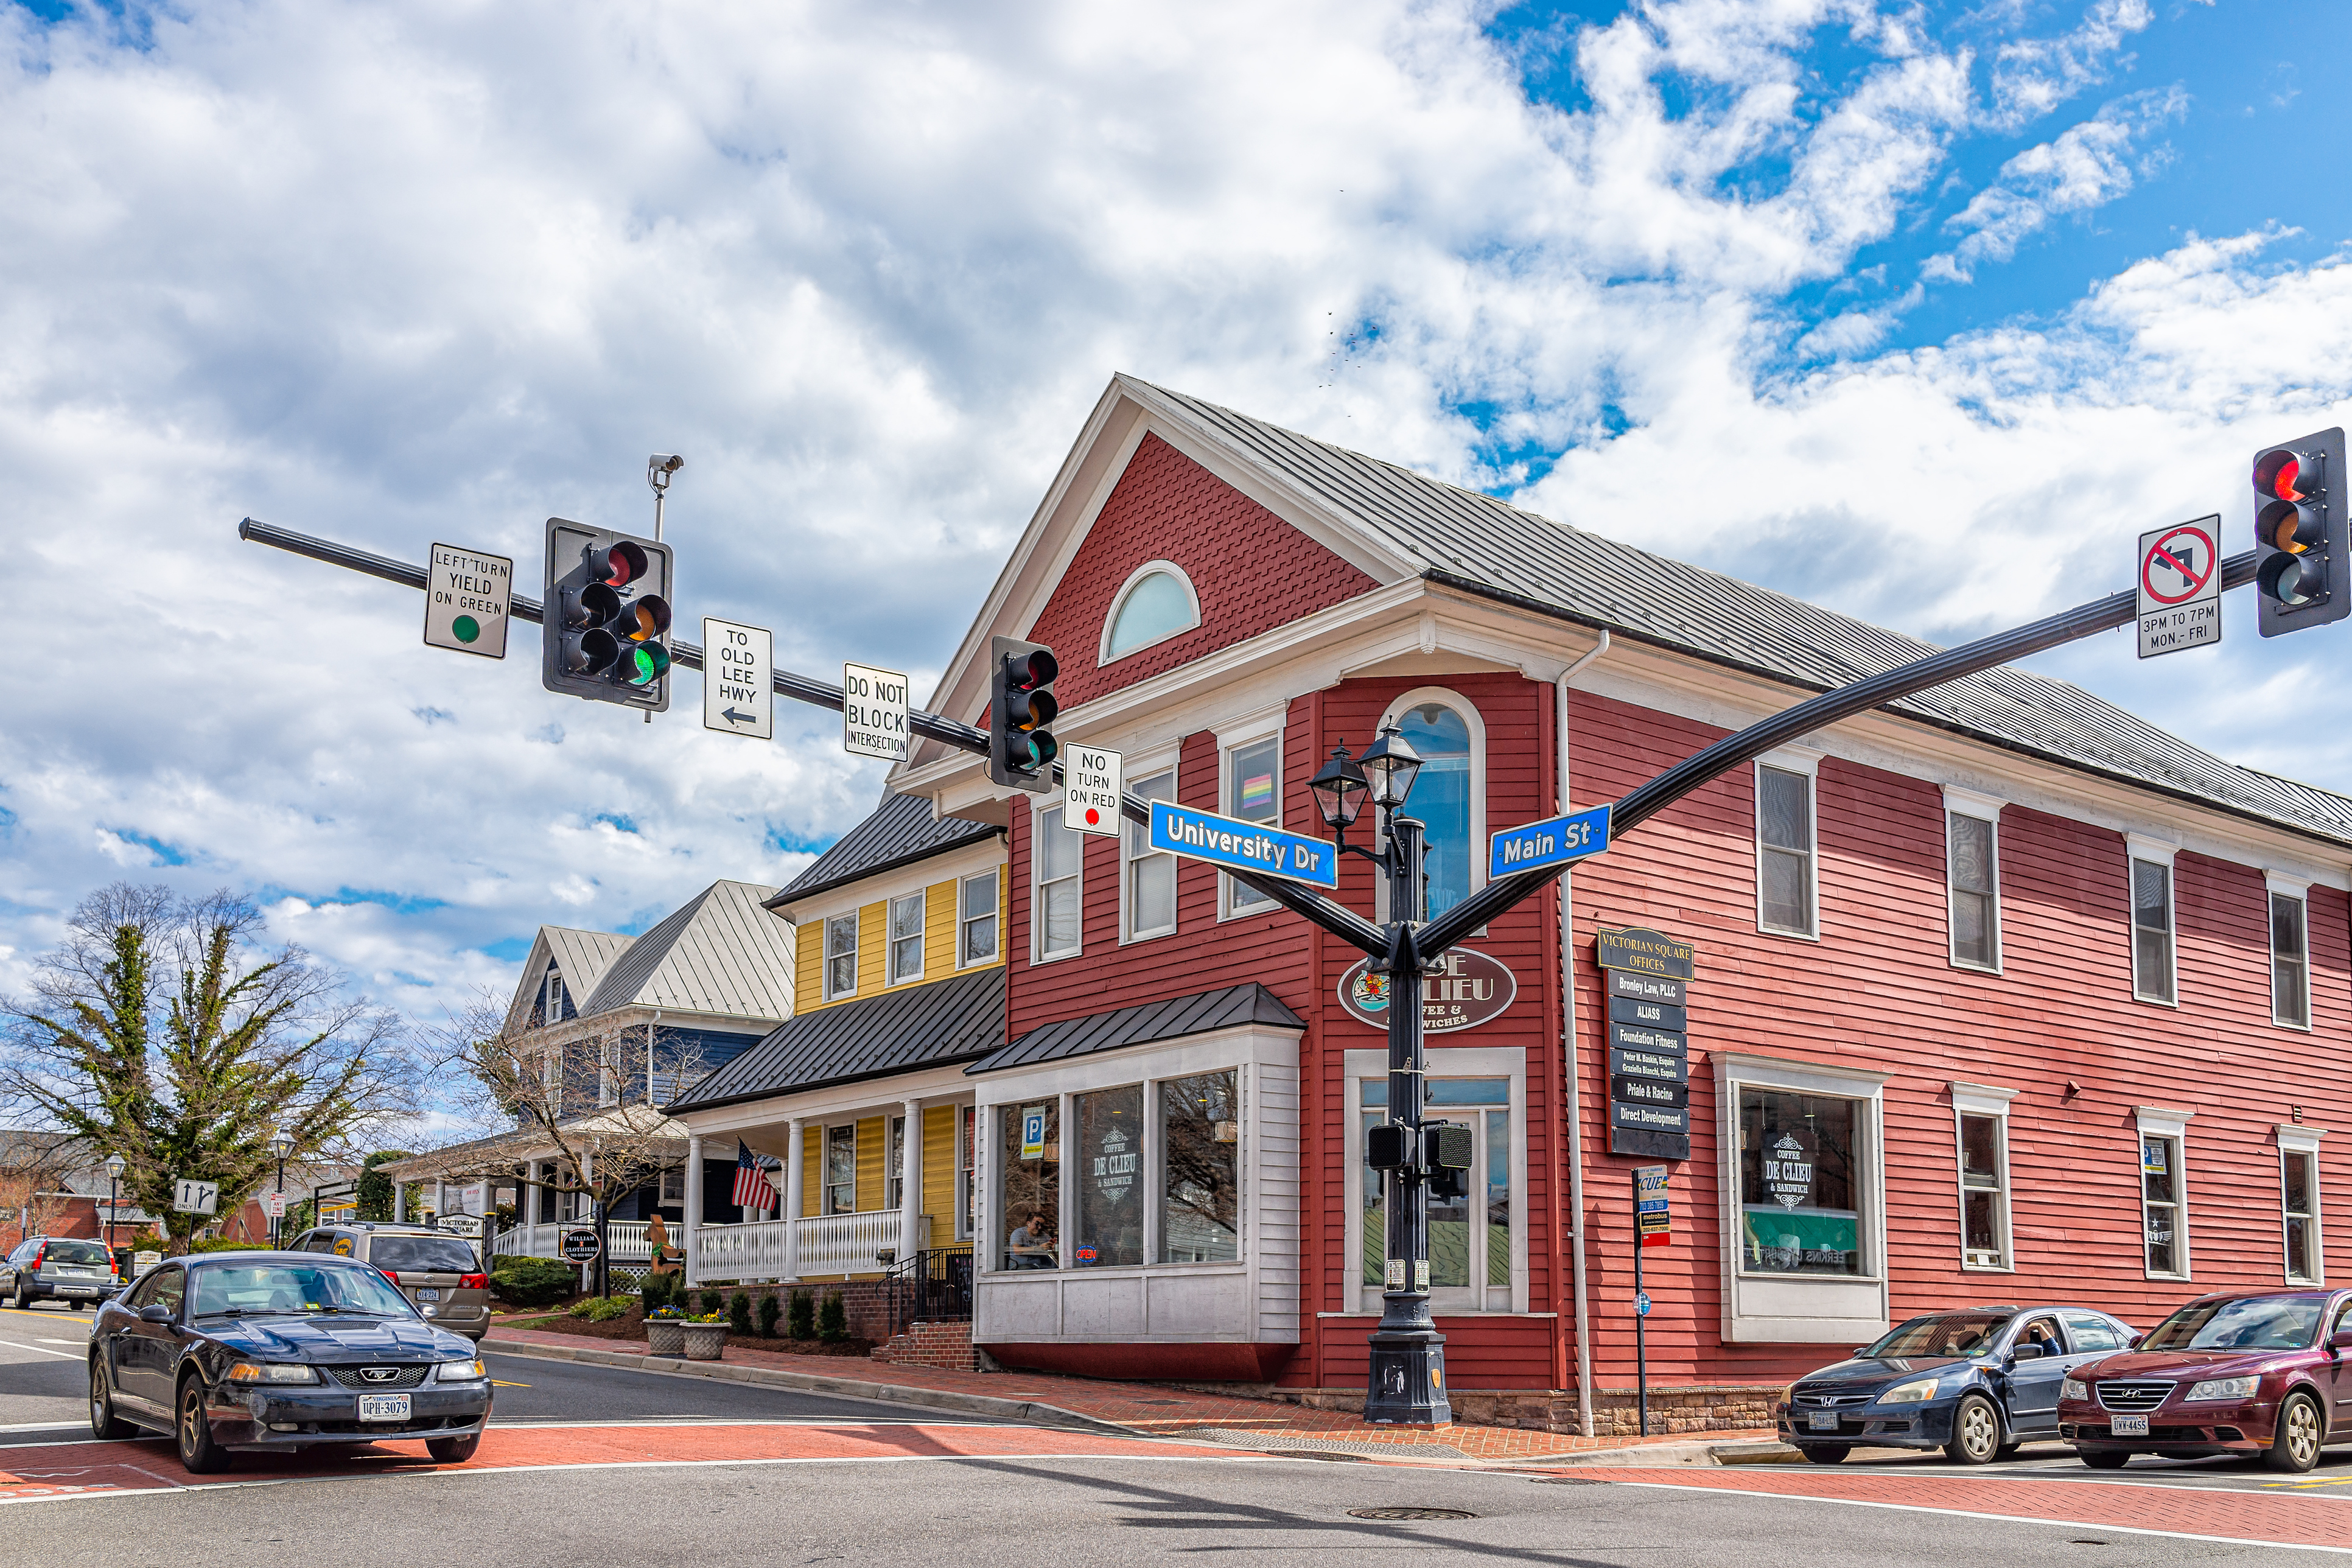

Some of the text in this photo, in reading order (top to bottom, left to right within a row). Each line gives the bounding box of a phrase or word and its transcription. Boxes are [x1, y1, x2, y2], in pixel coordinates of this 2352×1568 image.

[435, 551, 508, 578] LEFT TURN
[449, 573, 492, 595] YIELD
[435, 591, 502, 615] ON GREEN
[2143, 606, 2214, 632] 3PM TO 7PM
[727, 629, 747, 646] TO
[2189, 625, 2207, 640] FRI
[721, 647, 755, 665] OLD
[722, 667, 755, 685] LEE
[719, 684, 757, 704] HWY
[848, 676, 905, 705] DO NOT
[848, 704, 905, 733] BLOCK
[847, 730, 905, 754] INTERSECTION
[1082, 752, 1107, 771] NO
[1077, 772, 1110, 790] TURN
[1070, 789, 1116, 808] ON RED
[1167, 814, 1320, 871] University Dr
[1504, 821, 1591, 864] Main St
[1603, 934, 1690, 961] VICTORIAN SQUARE
[1629, 955, 1665, 971] OFFICES
[1423, 978, 1493, 1001] LIEU
[1619, 976, 1676, 998] Bronley Law, PLLC
[1451, 1005, 1461, 1015] &
[1637, 1005, 1661, 1020] ALIASS
[1620, 1029, 1678, 1049] Foundation Fitness
[1623, 1051, 1675, 1067] Peter M. Baskin, Esquire
[1622, 1063, 1677, 1079] Graziella Bianchi, Esquire
[1627, 1083, 1673, 1101] Priale & Racine
[1620, 1107, 1681, 1127] Direct Development
[1029, 1119, 1039, 1139] P
[1104, 1143, 1125, 1153] COFFEE
[1777, 1150, 1800, 1160] COFFEE
[1094, 1153, 1136, 1176] DE CLIEU
[1766, 1160, 1811, 1182] DE CLIEU
[1104, 1175, 1132, 1186] SANDWICH
[1640, 1177, 1662, 1191] CUE
[1770, 1182, 1808, 1194] & SANDWICH
[1076, 1250, 1096, 1259] OPEN
[363, 1401, 408, 1414] UPH-3079
